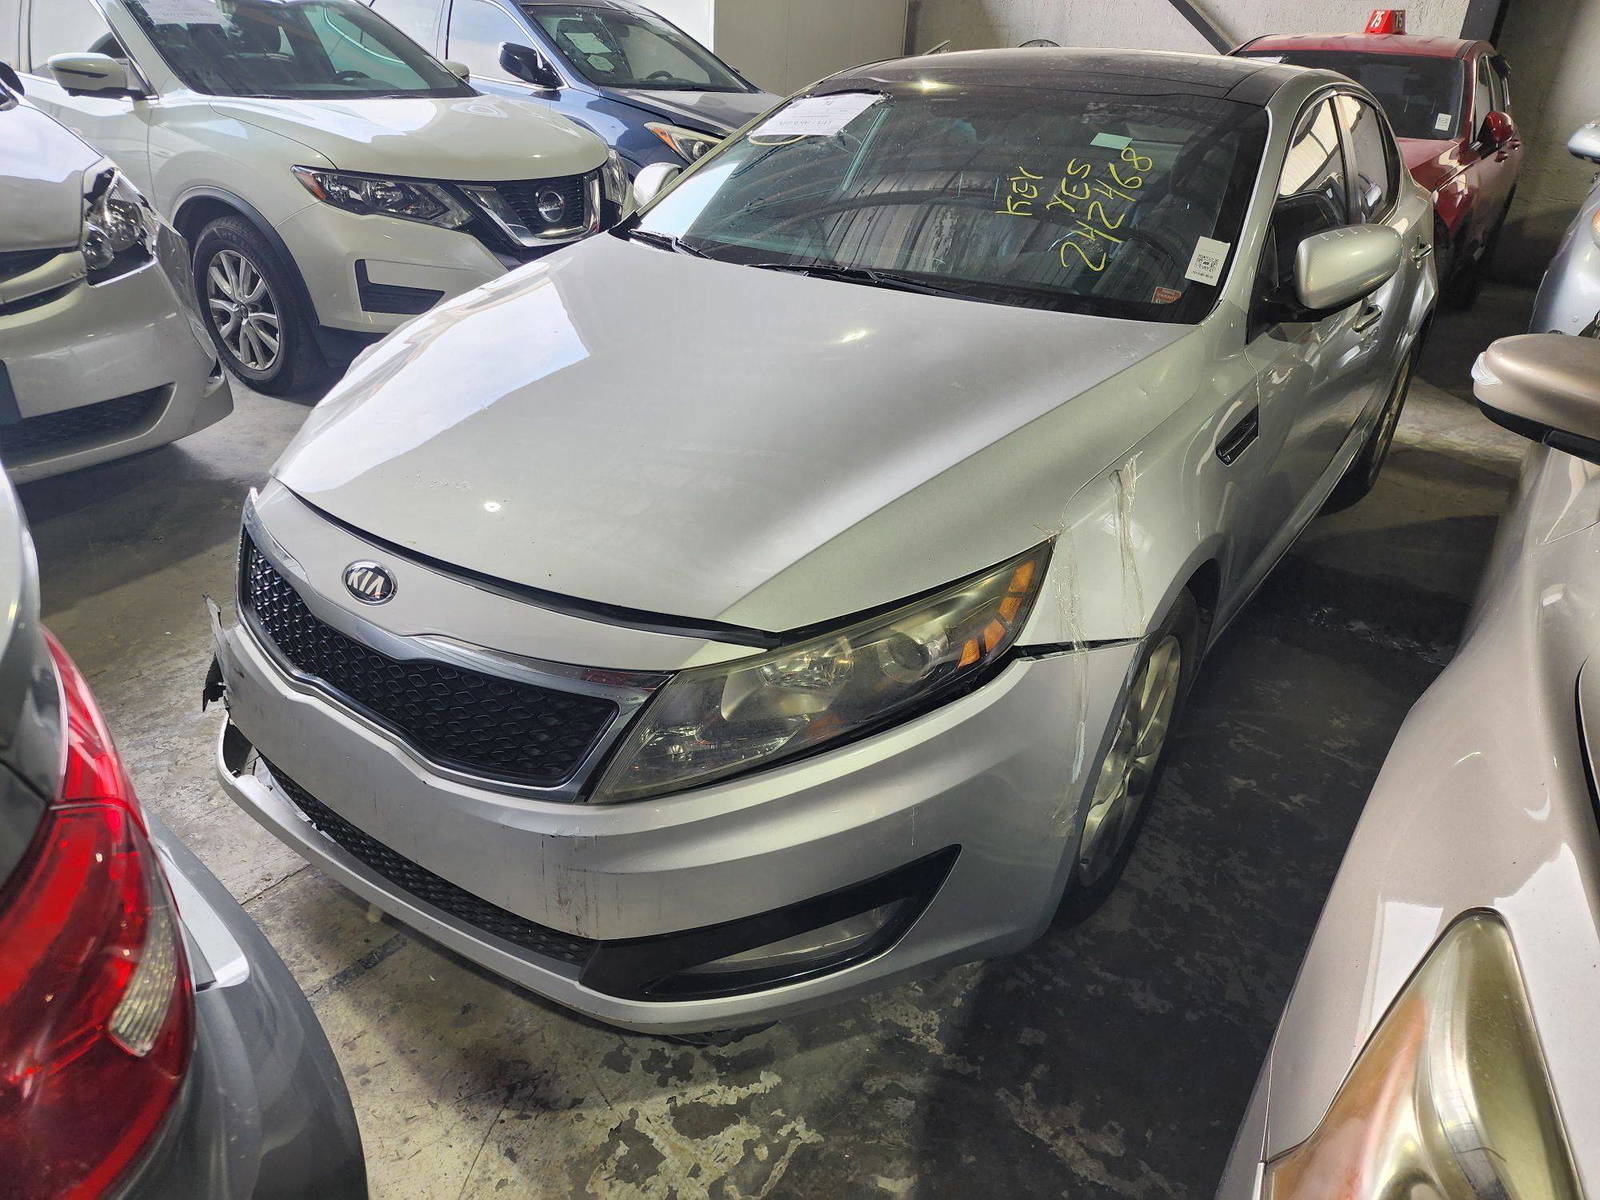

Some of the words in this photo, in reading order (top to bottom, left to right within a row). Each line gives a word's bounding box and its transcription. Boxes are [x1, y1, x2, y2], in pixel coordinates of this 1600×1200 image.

[1371, 10, 1385, 28] 75
[1395, 11, 1403, 29] 75
[1046, 158, 1092, 213] YES
[1060, 146, 1153, 272] 242468
[347, 567, 385, 599] KIA
